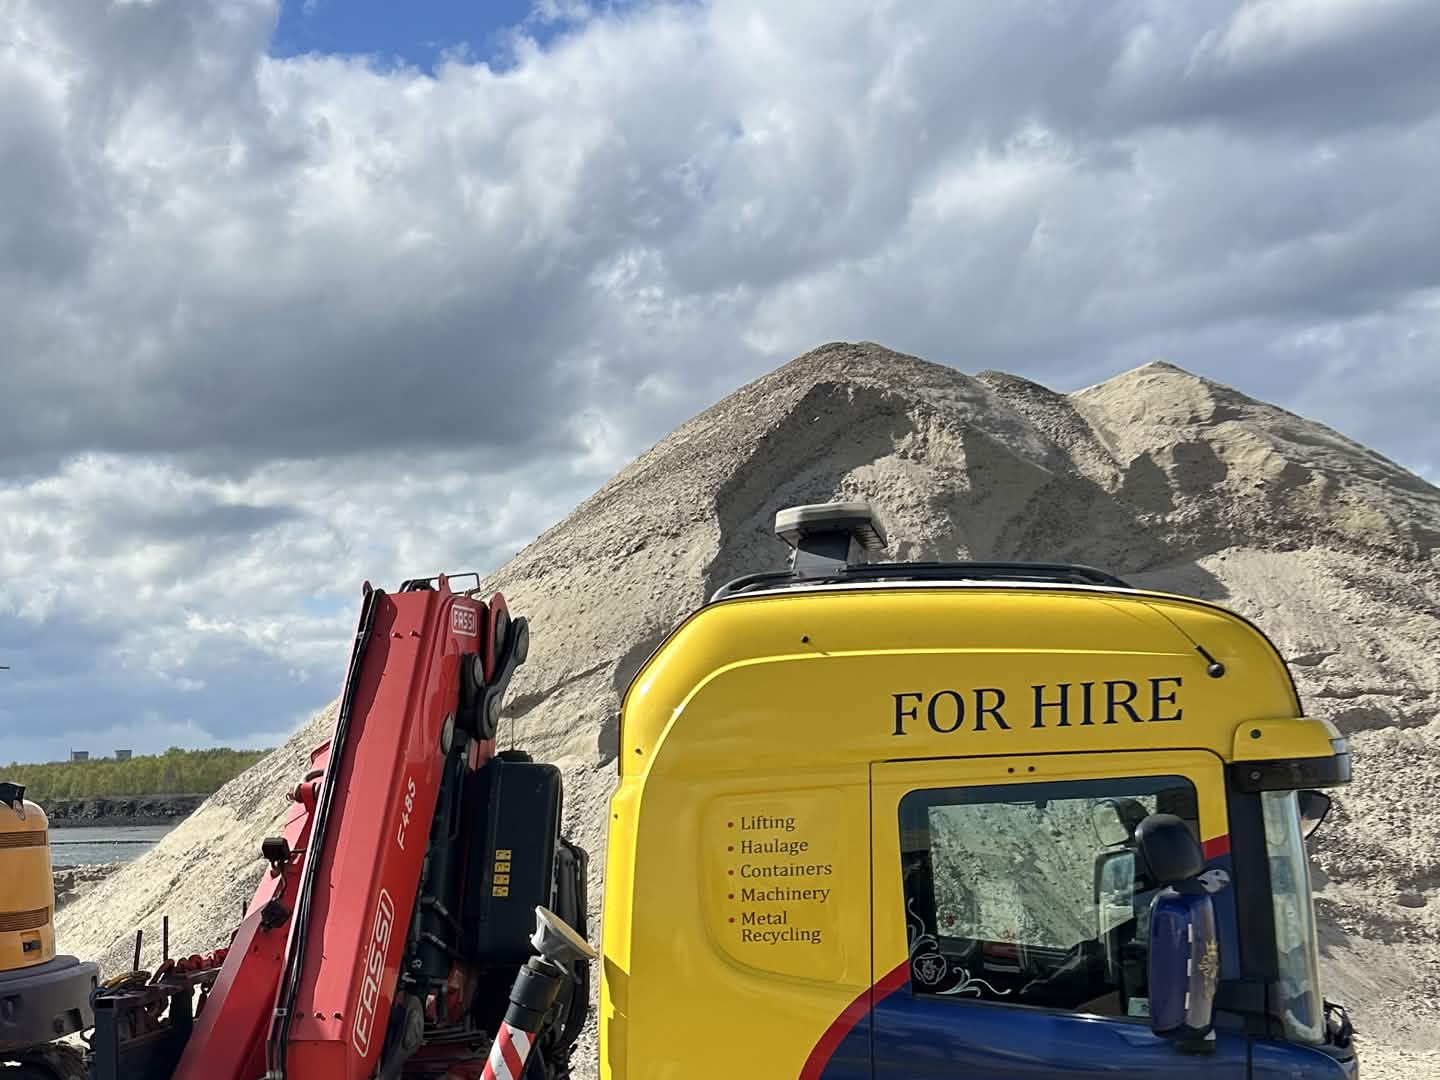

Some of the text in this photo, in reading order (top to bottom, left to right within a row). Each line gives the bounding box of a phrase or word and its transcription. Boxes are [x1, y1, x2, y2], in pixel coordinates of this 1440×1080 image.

[453, 608, 475, 633] FASSI
[891, 676, 1184, 736] FOR HIRE
[741, 816, 796, 832] Lifting
[741, 838, 809, 856] Haulage
[741, 863, 832, 878] Containers
[741, 887, 830, 904] Machinery
[742, 910, 787, 926] Metal
[742, 927, 822, 946] Recycling
[356, 900, 392, 1045] FASSI
